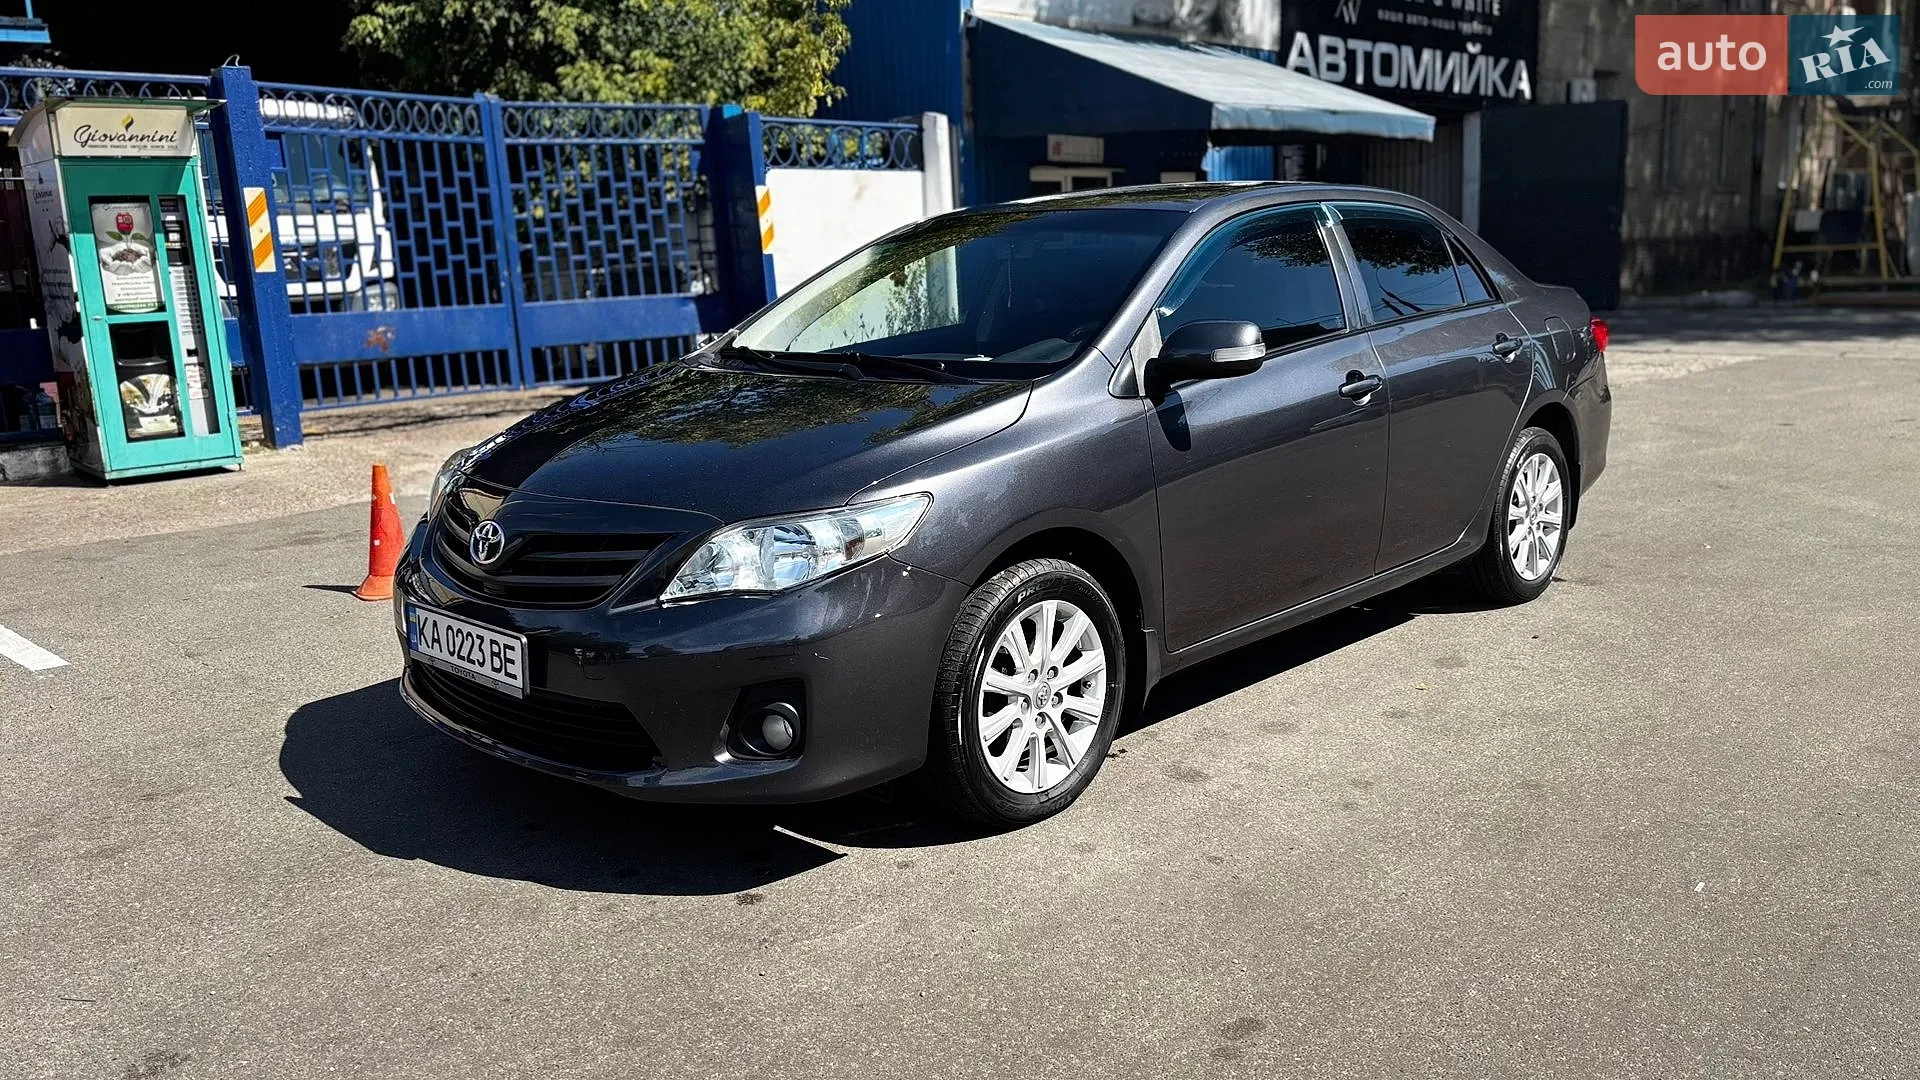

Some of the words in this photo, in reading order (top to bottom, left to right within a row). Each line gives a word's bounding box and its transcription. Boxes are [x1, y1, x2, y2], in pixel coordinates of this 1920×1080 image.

[1285, 31, 1532, 100] АВТОМИЙКА
[73, 124, 177, 148] Giovannini
[417, 614, 443, 653] KA
[446, 624, 486, 668] 0223
[489, 638, 518, 680] BE
[449, 665, 477, 680] TOYOTA
